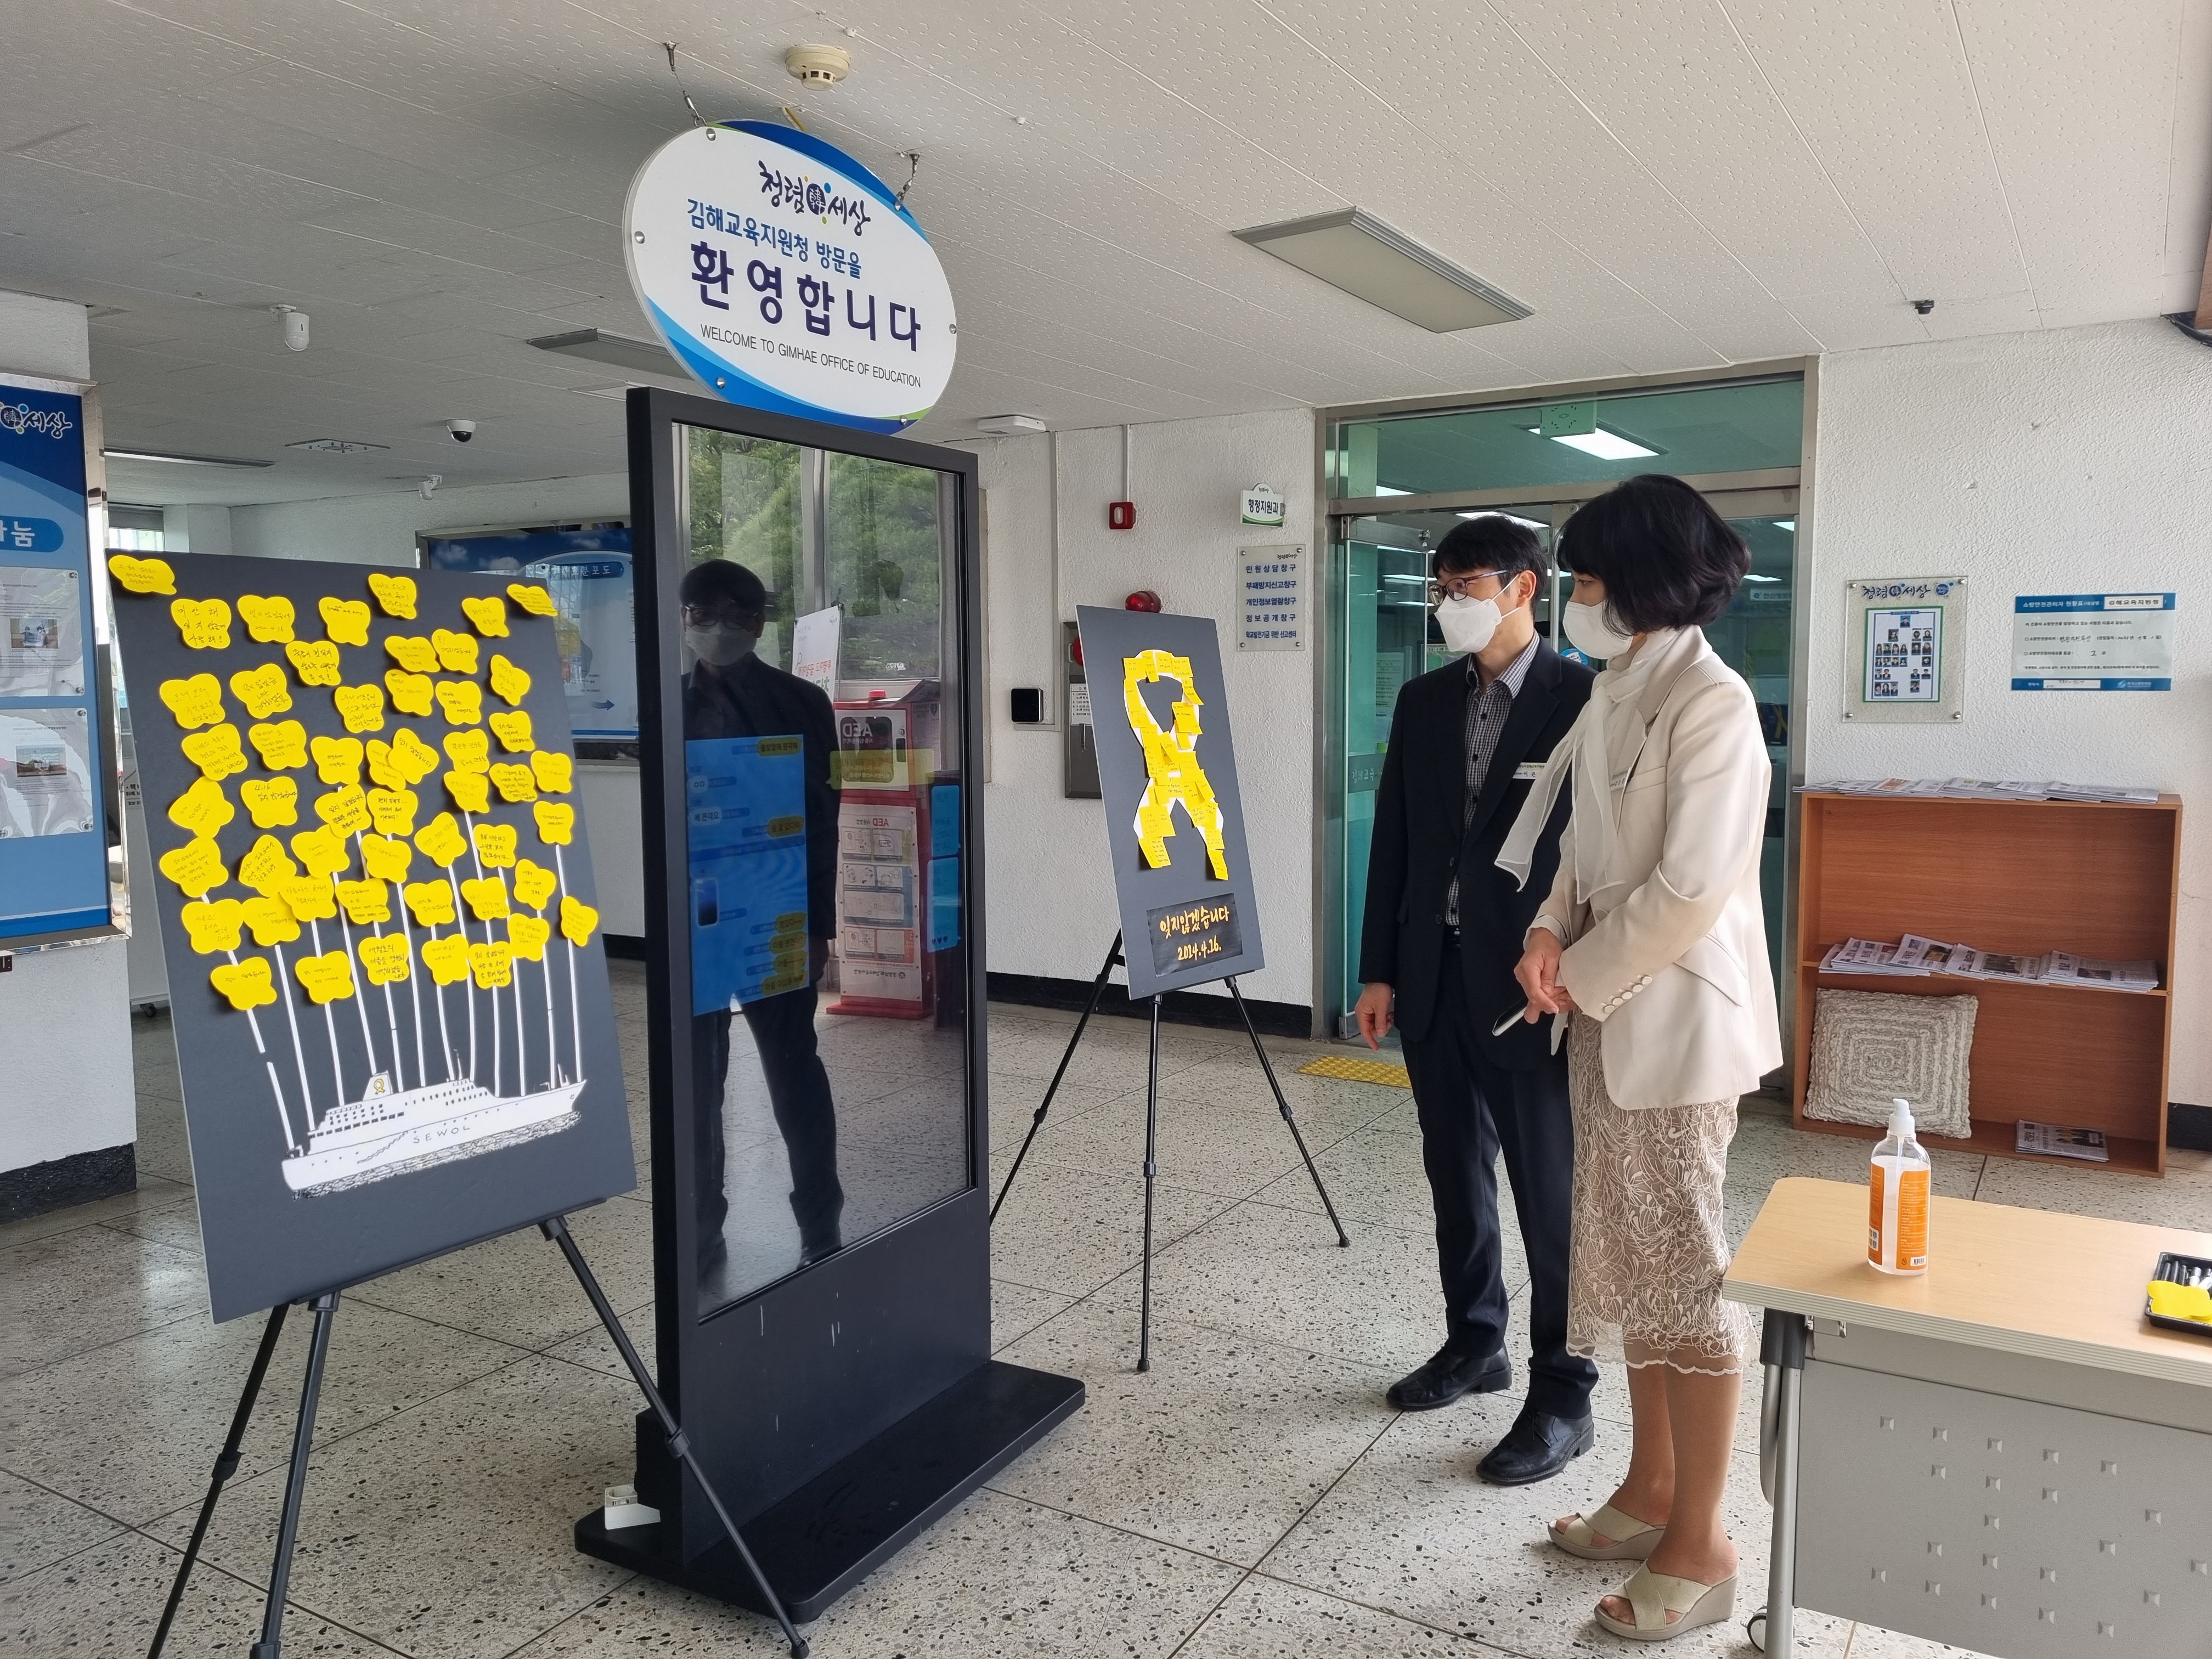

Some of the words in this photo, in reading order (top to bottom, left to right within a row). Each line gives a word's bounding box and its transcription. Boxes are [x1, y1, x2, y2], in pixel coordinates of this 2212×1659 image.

[687, 197, 810, 262] 김해교육지원청
[816, 240, 862, 280] 방문을
[690, 240, 921, 352] 환영합니다
[701, 323, 757, 350] WELCOME
[760, 338, 775, 353] TO
[778, 343, 818, 364] GIMHAE
[820, 352, 854, 373] OFFICE
[857, 361, 870, 375] OF
[873, 365, 921, 388] EDUCATION
[1248, 498, 1279, 515] 행정지원과
[1245, 580, 1297, 590] 부패방지신고창구
[1245, 597, 1297, 607] 개인정보열람창구
[1160, 905, 1230, 939] 잊지않겠습니다
[1177, 934, 1222, 961] 2014.4.16.
[413, 1125, 471, 1144] SEWOL
